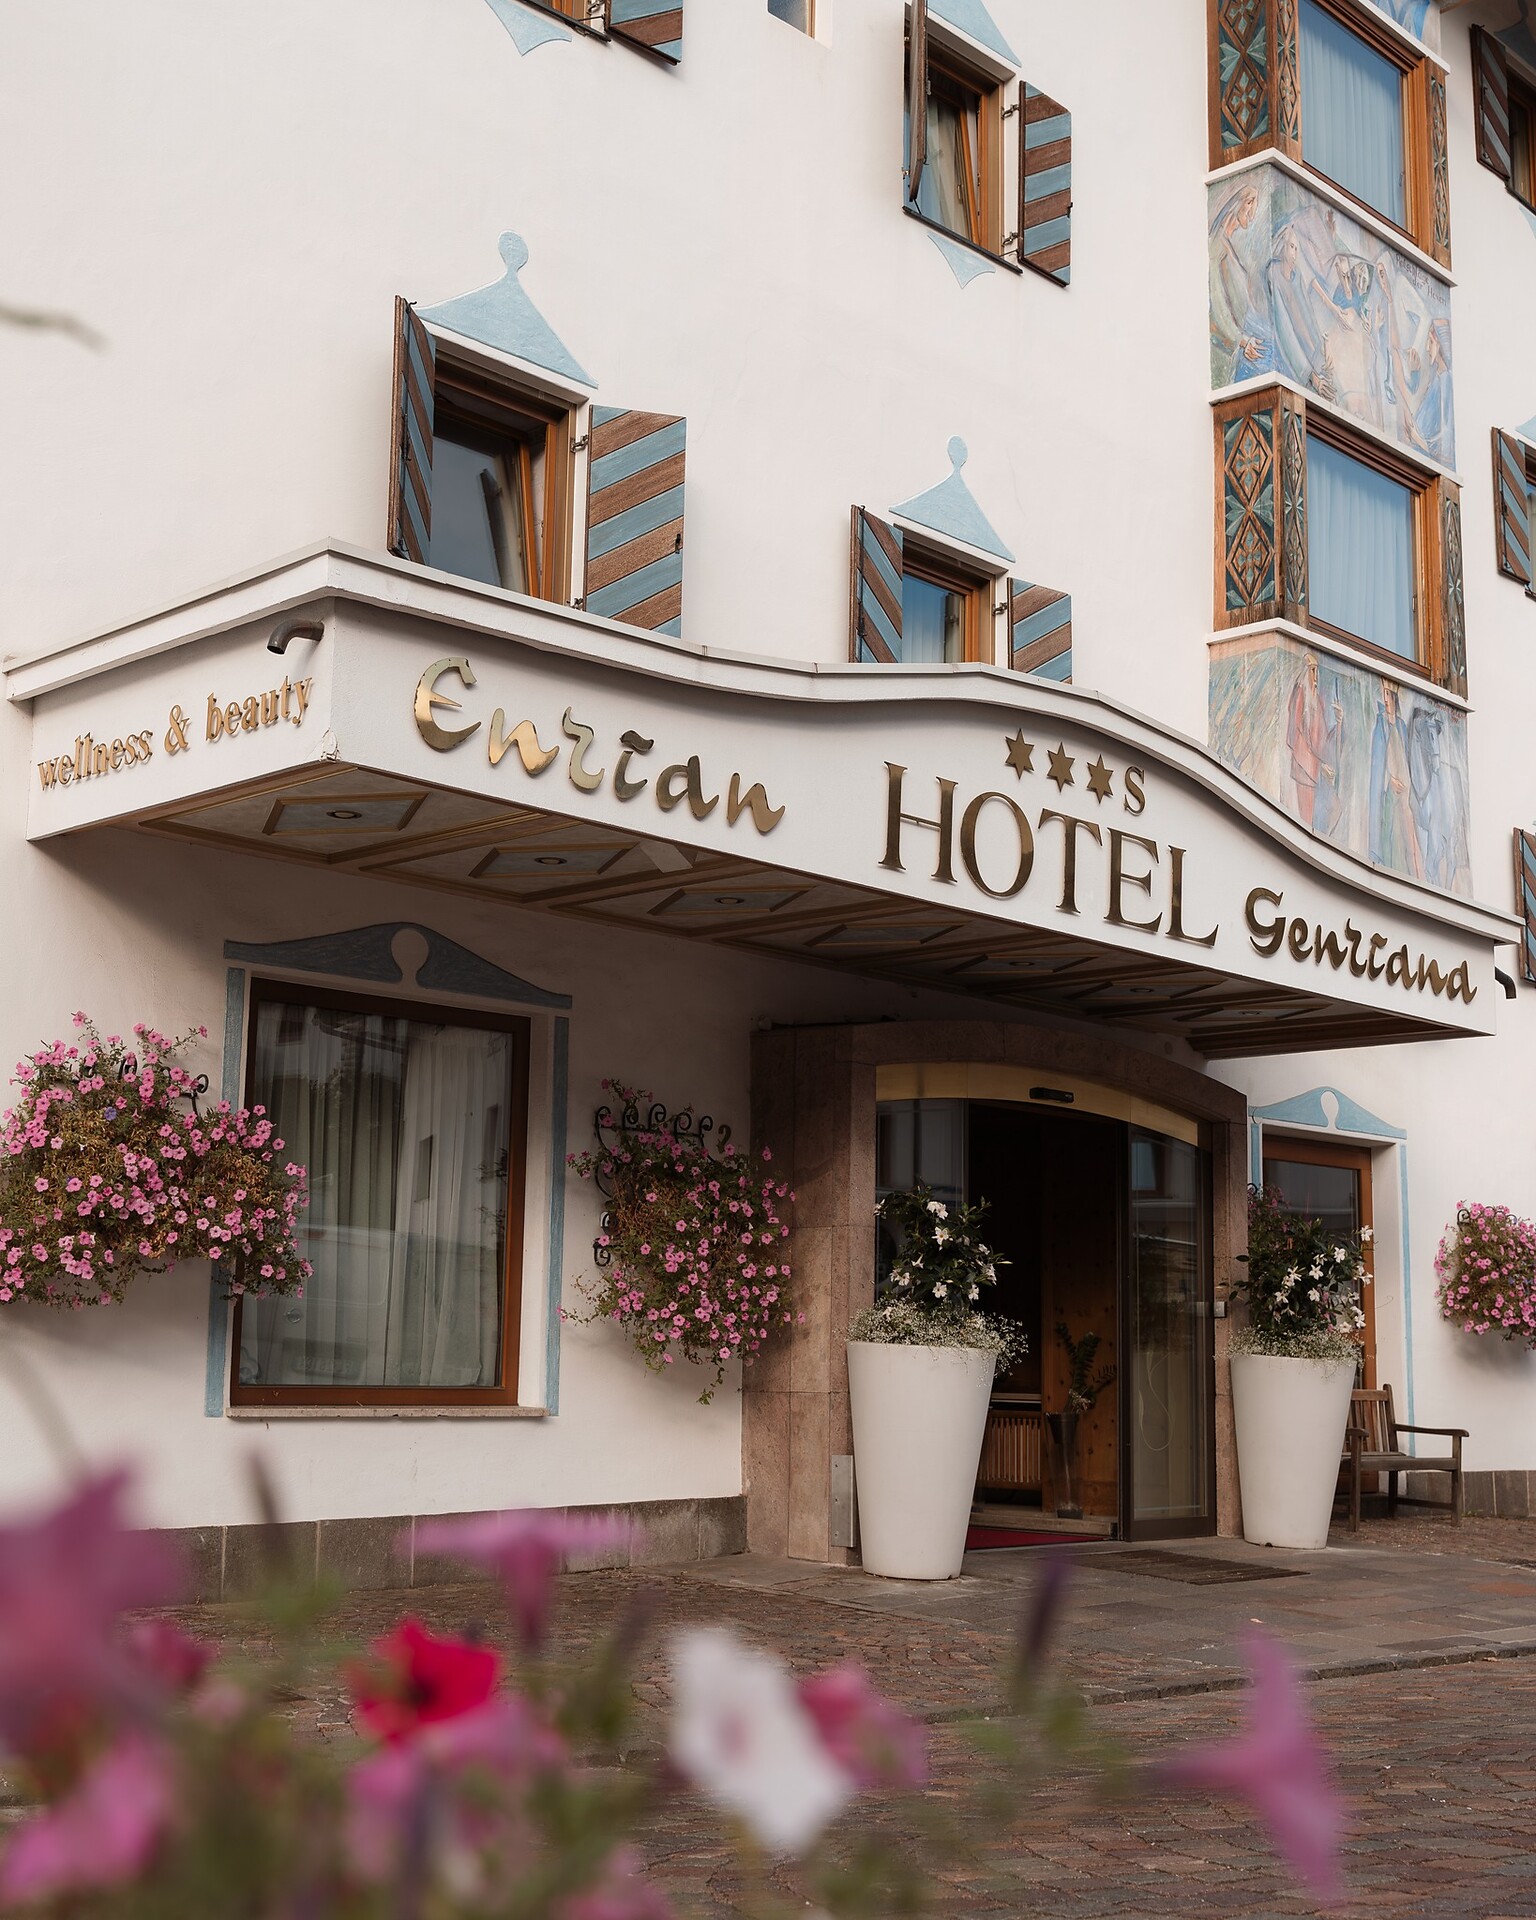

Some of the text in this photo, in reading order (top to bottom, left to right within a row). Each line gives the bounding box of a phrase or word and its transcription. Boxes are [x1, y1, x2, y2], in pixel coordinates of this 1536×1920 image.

[37, 675, 313, 791] wellness & beauty
[1124, 765, 1146, 816] S
[413, 656, 1478, 1004] Enzian HOTEL Genziana
